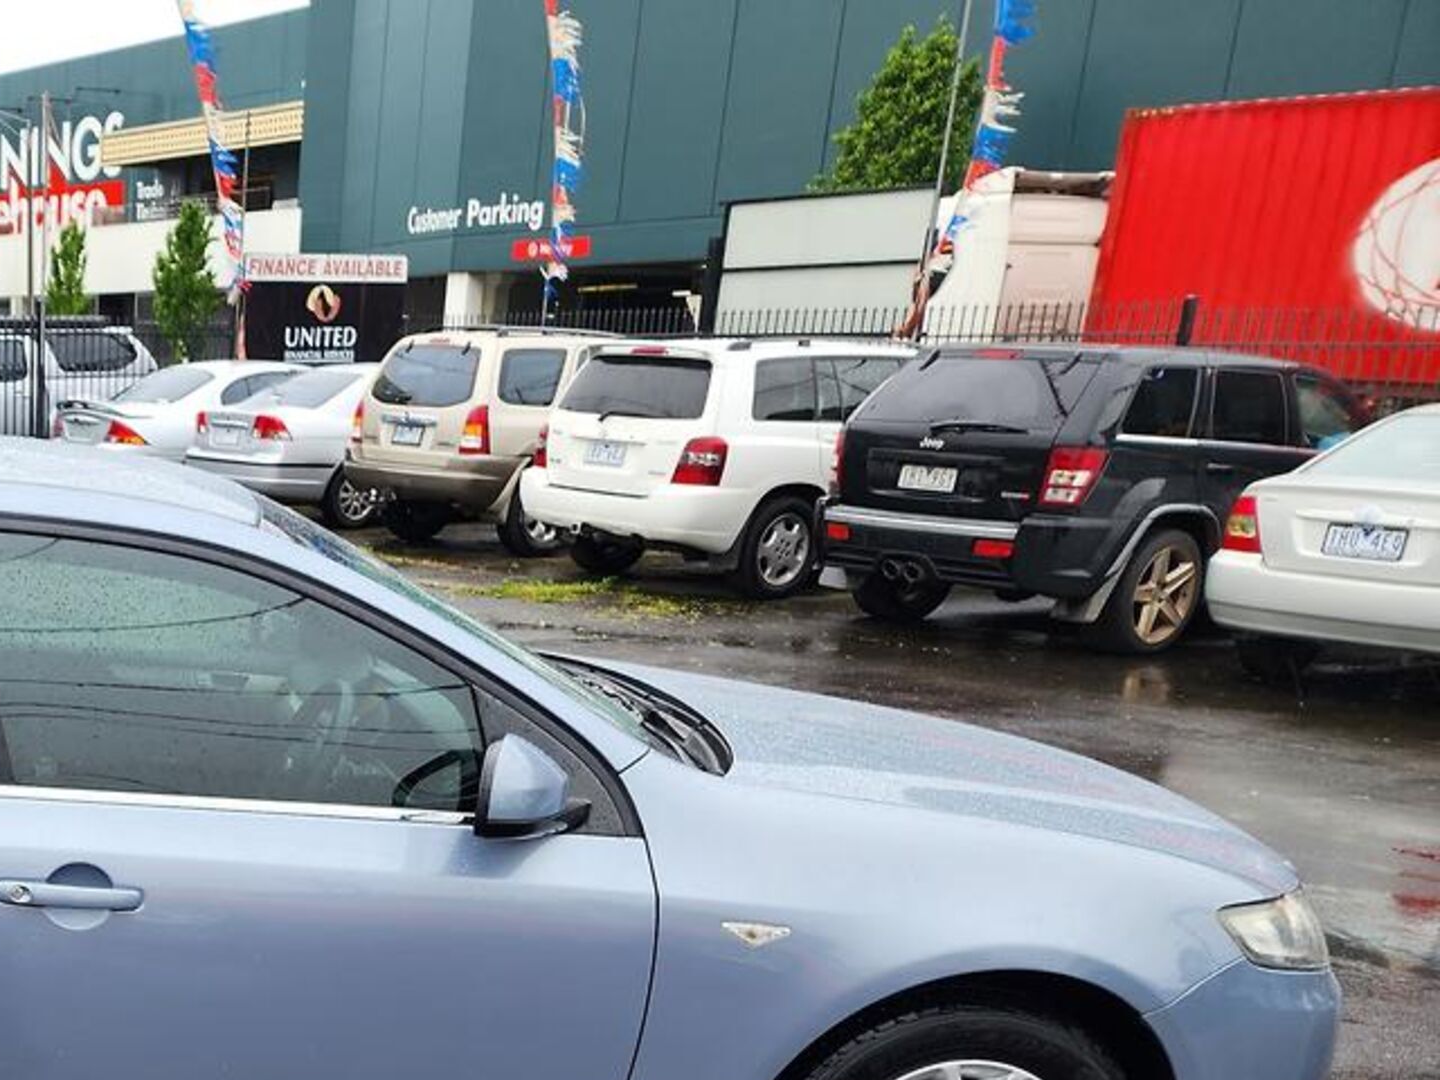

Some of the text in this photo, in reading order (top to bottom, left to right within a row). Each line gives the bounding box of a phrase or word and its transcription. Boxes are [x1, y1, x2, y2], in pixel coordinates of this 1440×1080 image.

[407, 192, 544, 234] Customer Parking
[248, 257, 403, 277] FINANCE AVAILABLE
[285, 326, 358, 347] UNITED
